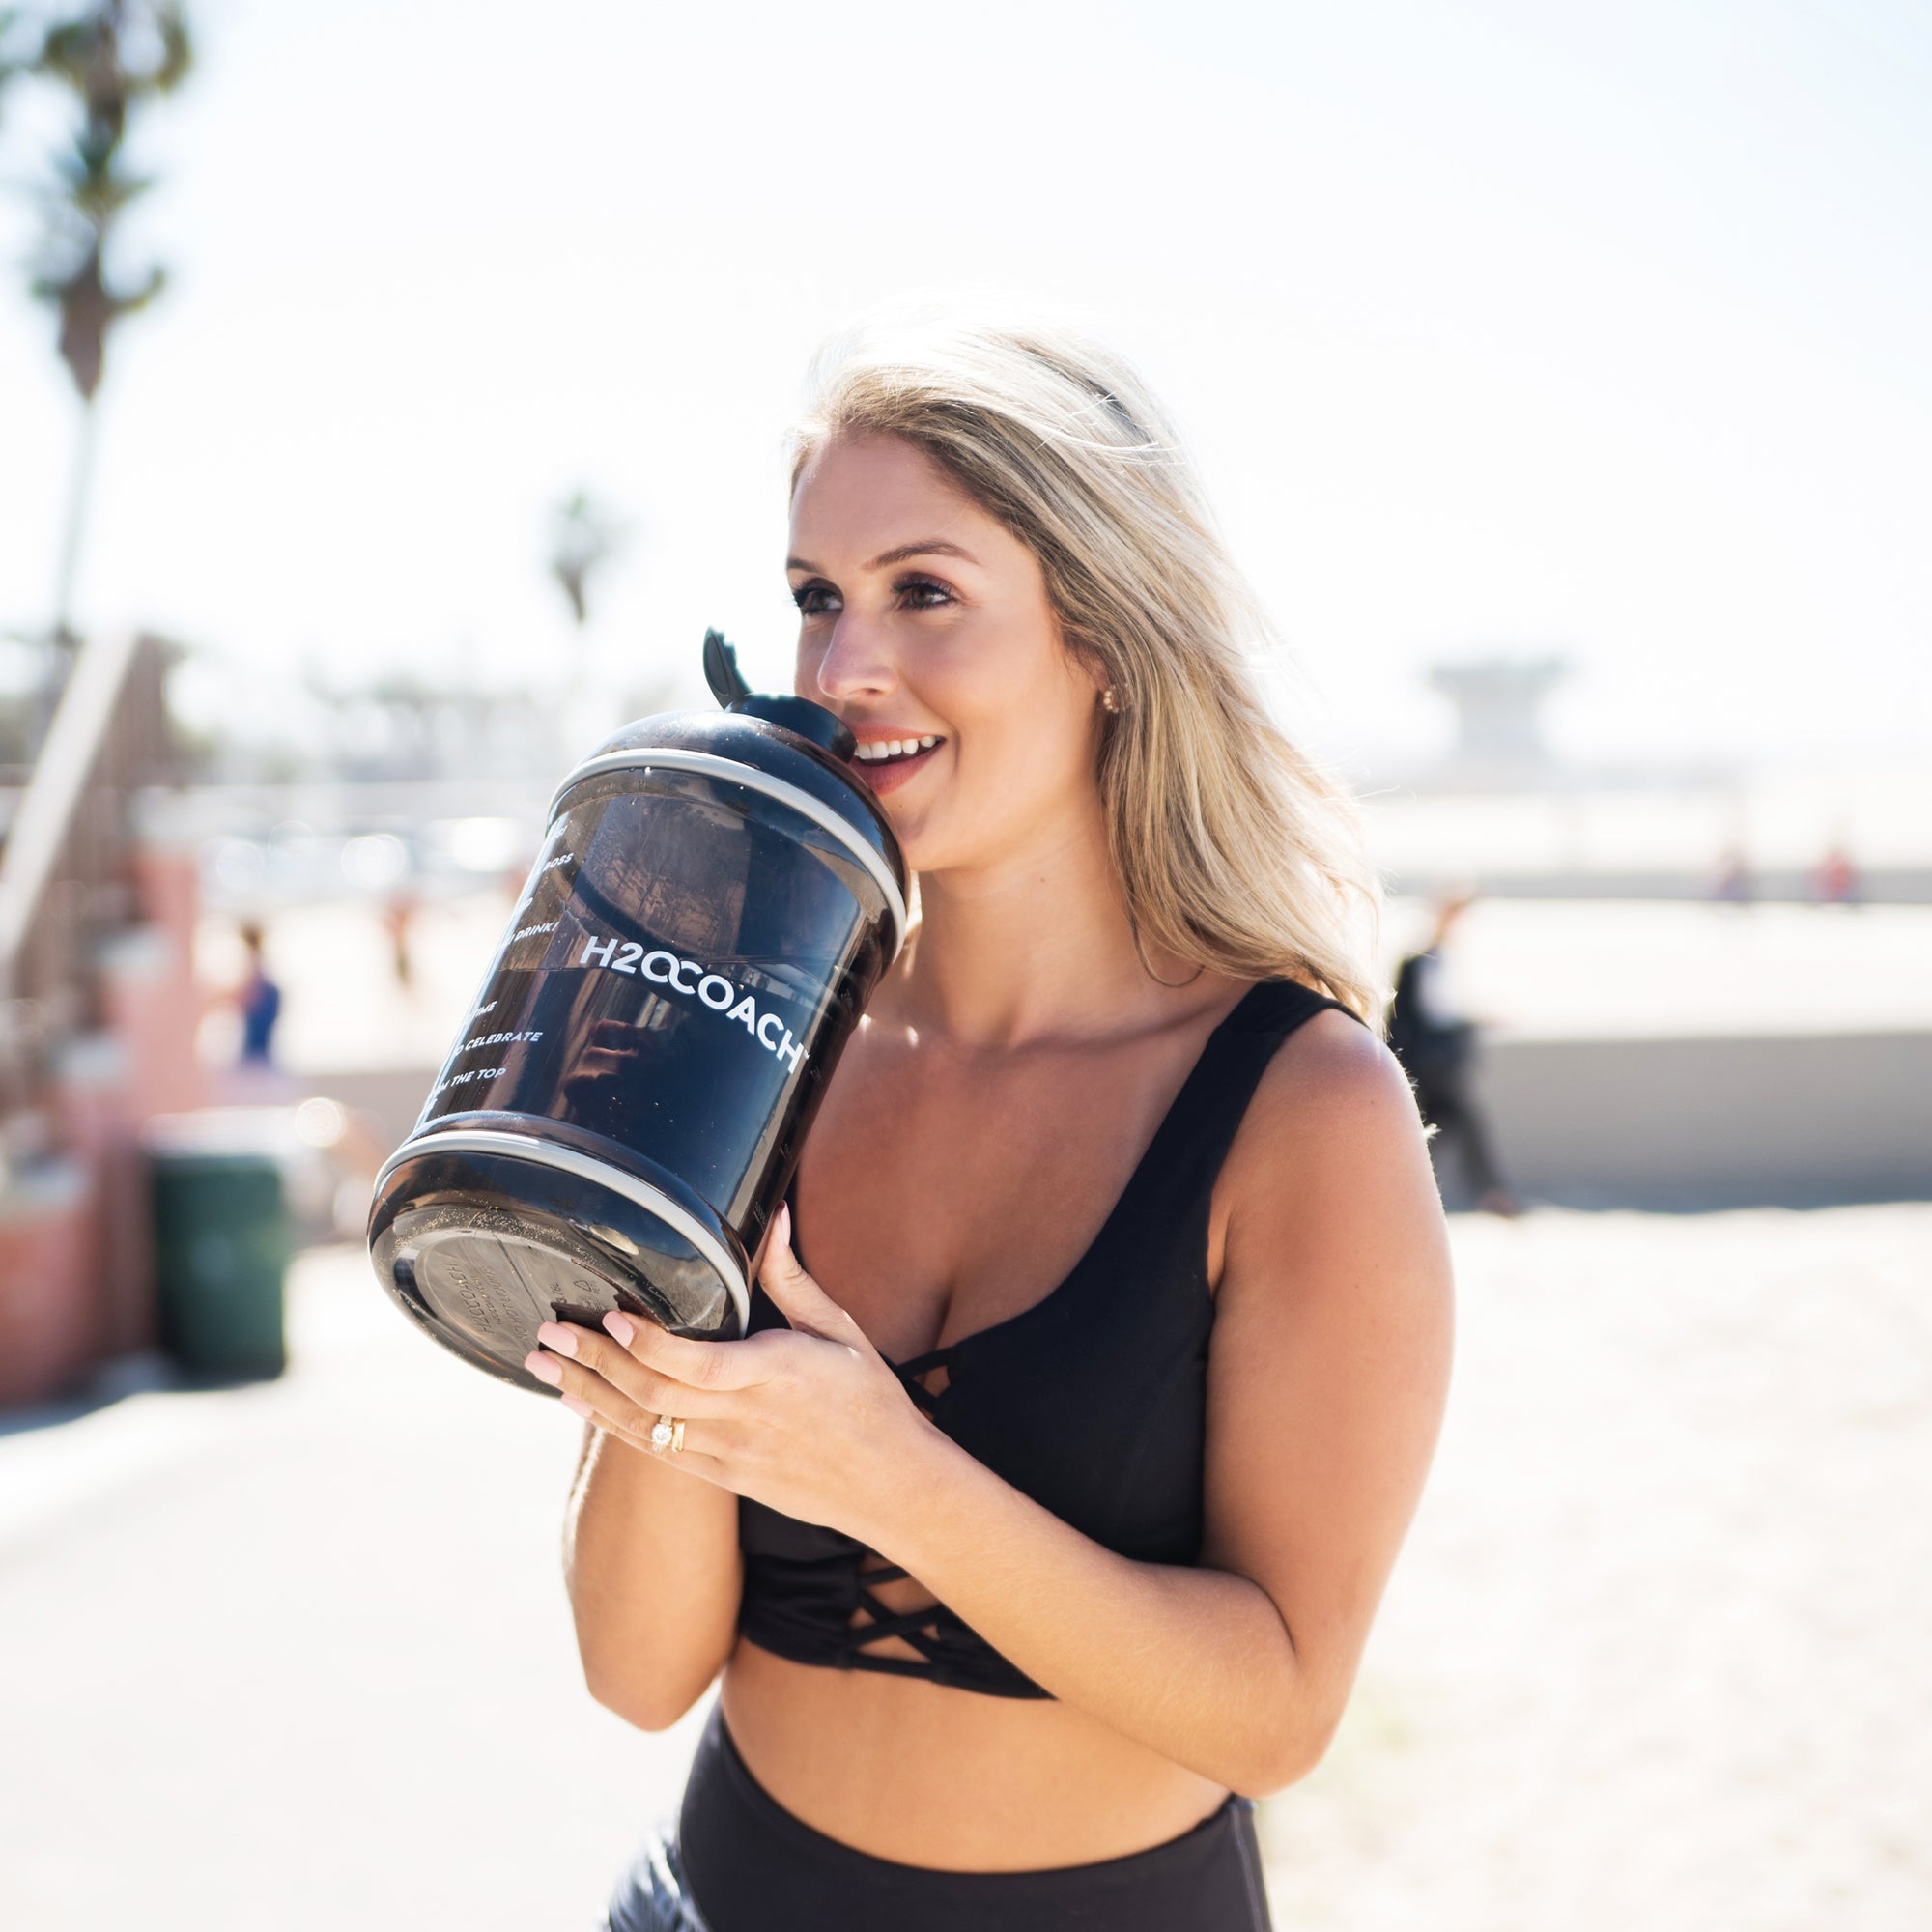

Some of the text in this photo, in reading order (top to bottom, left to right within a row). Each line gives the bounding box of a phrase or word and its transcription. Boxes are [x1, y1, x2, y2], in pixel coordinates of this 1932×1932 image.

[513, 921, 560, 942] DRINK!
[465, 1031, 544, 1051] CELEBRATE
[450, 1071, 475, 1087] THE
[476, 1067, 507, 1081] TOP
